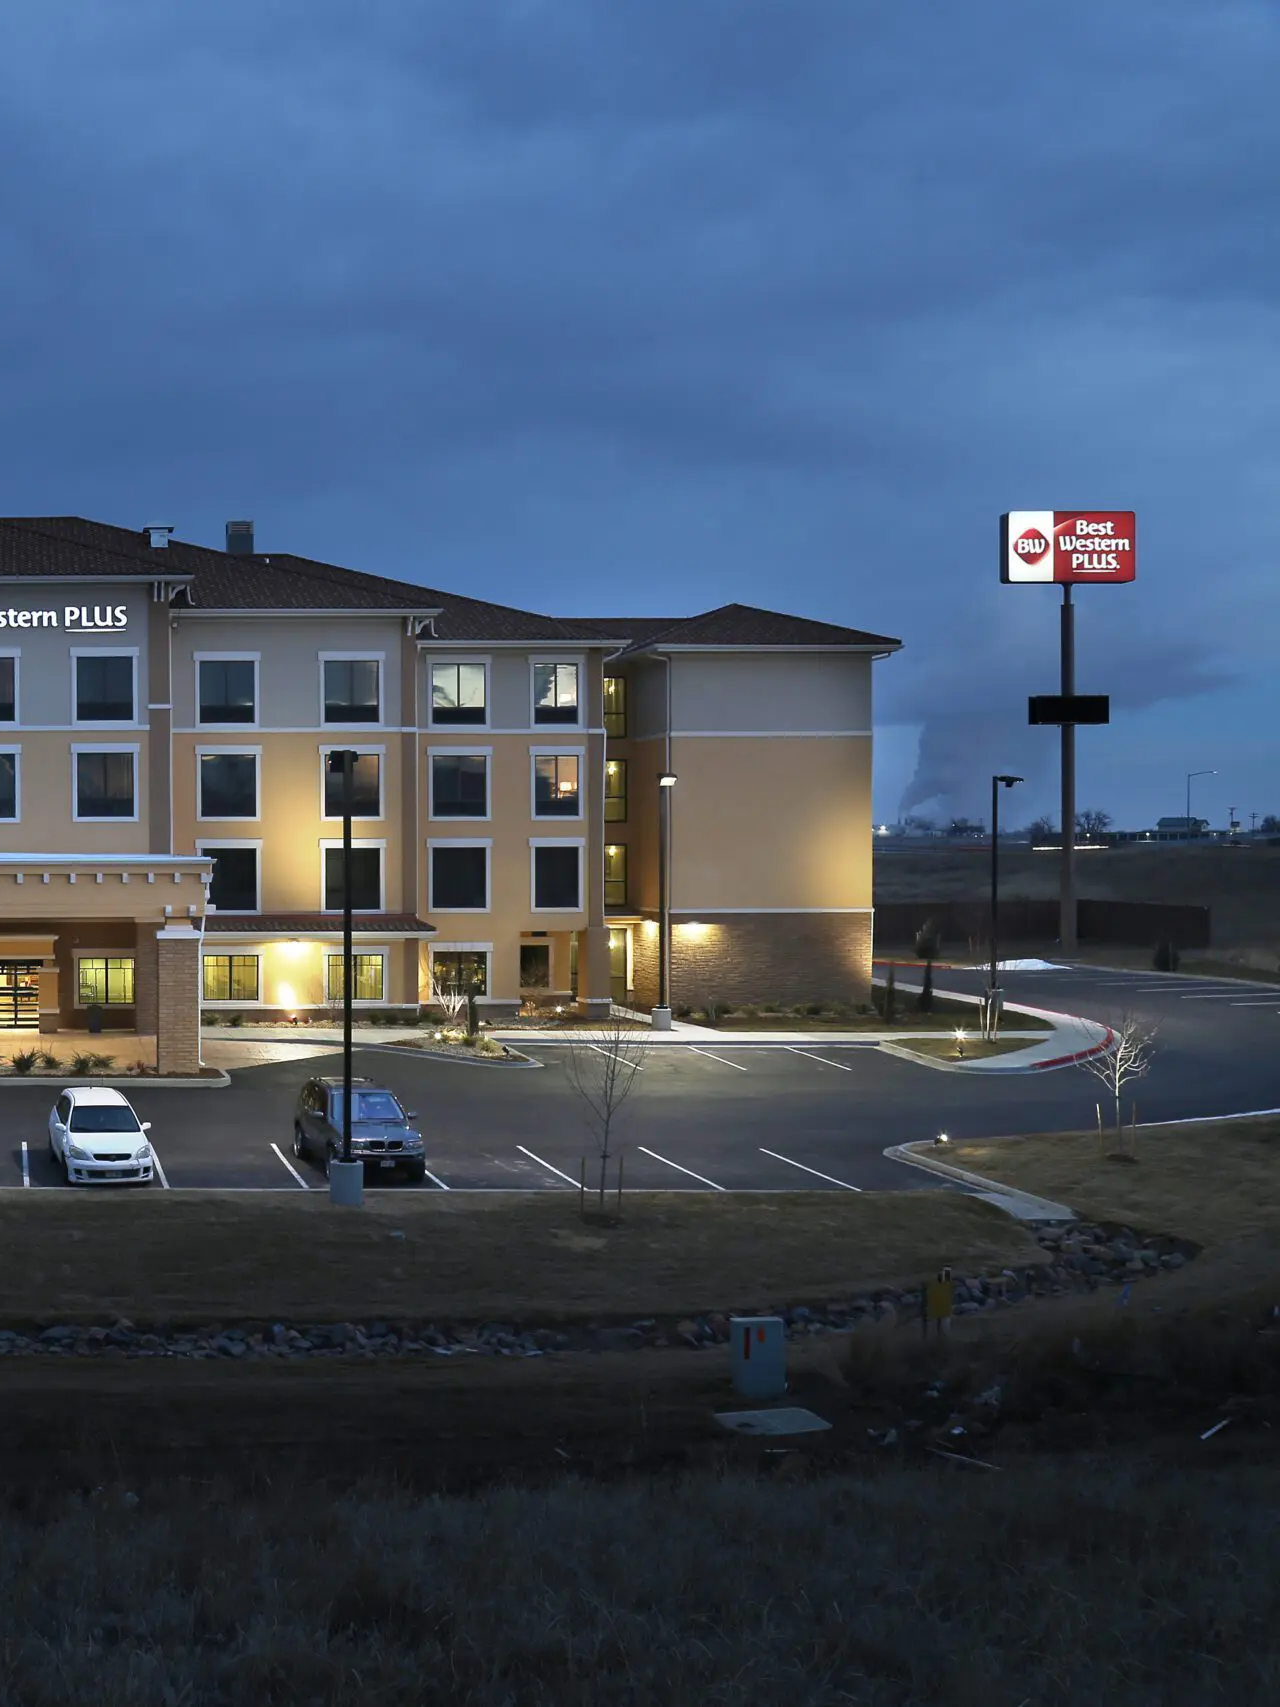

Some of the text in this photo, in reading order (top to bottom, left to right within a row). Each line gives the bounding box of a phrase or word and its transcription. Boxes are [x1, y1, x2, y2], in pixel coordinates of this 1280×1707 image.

[1076, 519, 1115, 536] Best
[1017, 538, 1046, 554] BW
[1058, 536, 1131, 551] Western
[64, 605, 128, 628] PLUS
